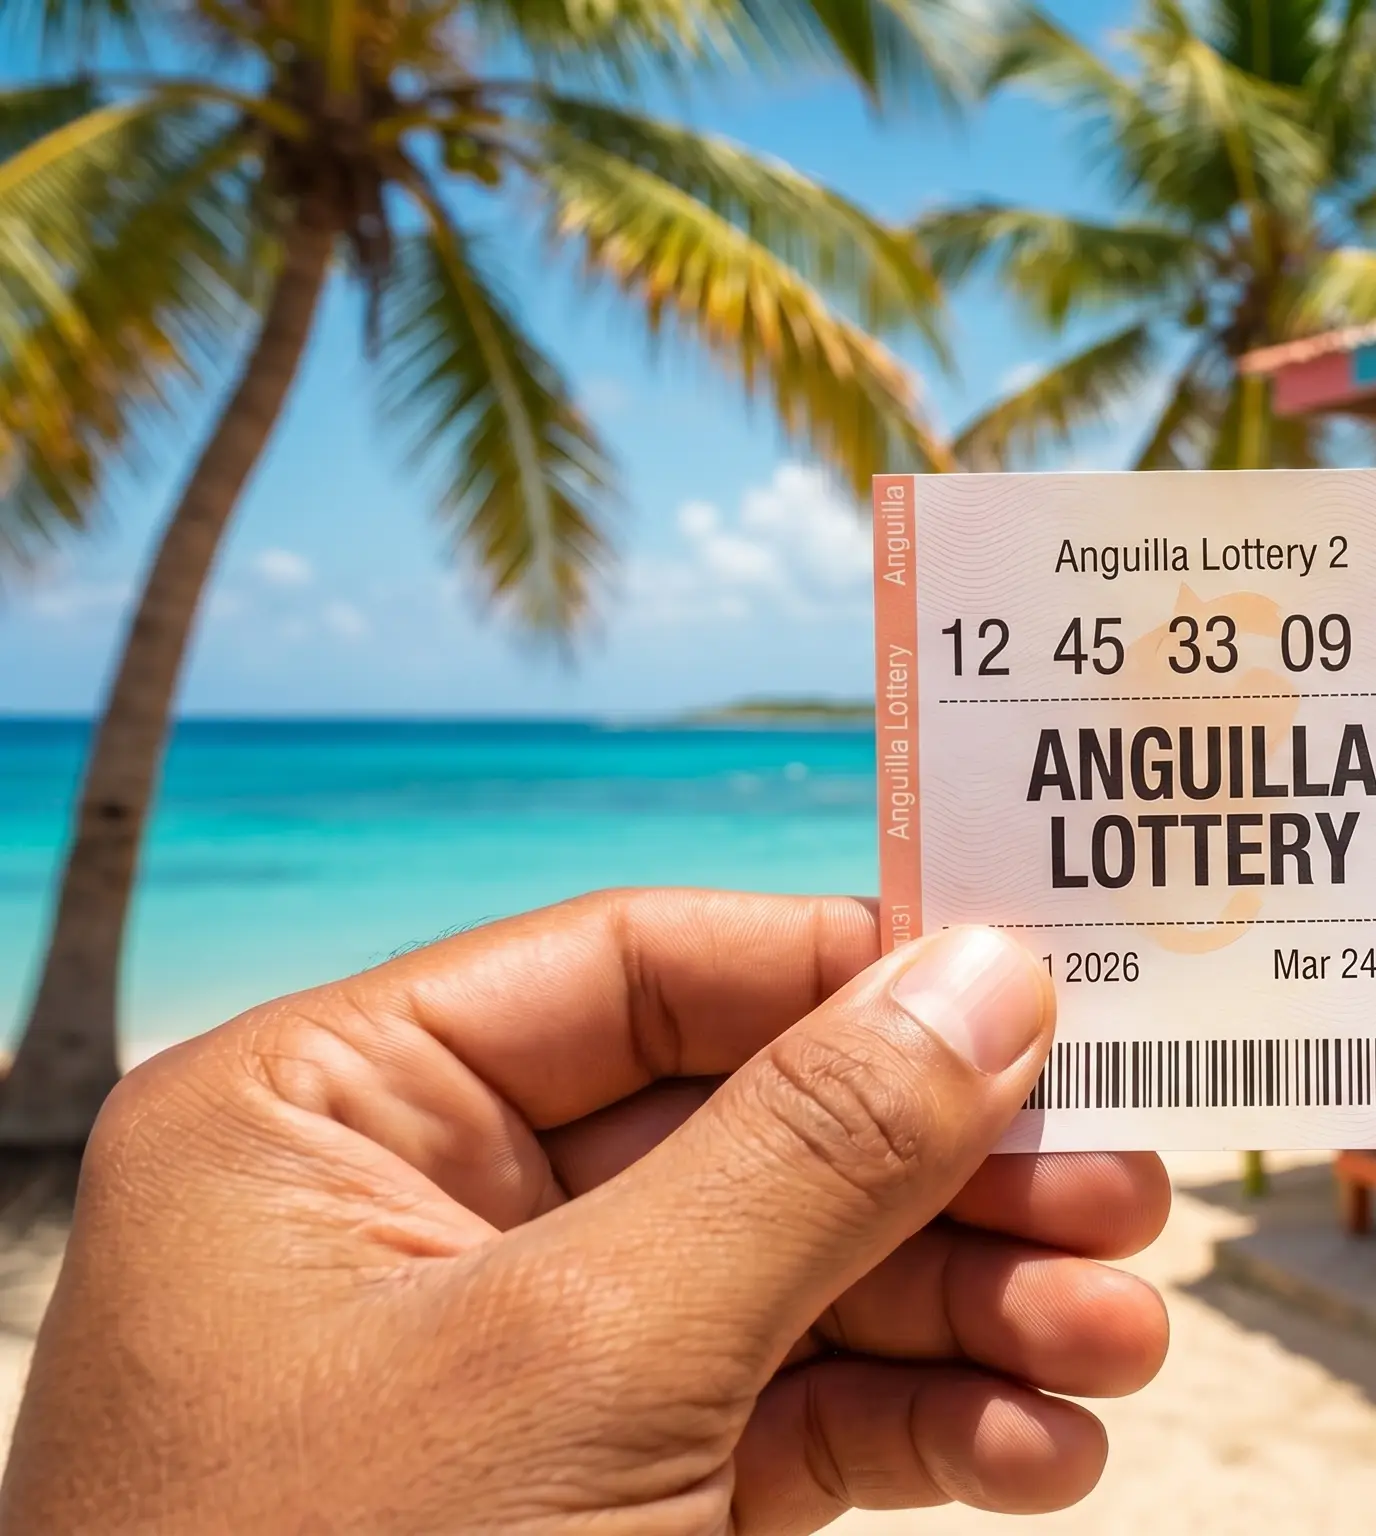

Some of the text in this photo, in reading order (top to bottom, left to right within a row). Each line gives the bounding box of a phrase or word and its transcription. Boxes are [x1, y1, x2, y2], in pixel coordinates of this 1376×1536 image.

[880, 484, 908, 586] Anguilla
[1054, 535, 1349, 581] Anguilla Lottery 2
[941, 618, 1010, 677] 12
[1053, 617, 1125, 676] 45
[1168, 615, 1239, 675] 33
[1281, 613, 1352, 673] 09
[884, 644, 913, 840] Anguilla Lottery
[1050, 811, 1361, 889] LOTTERY
[1065, 951, 1140, 983] 2026
[1274, 948, 1331, 980] Mar
